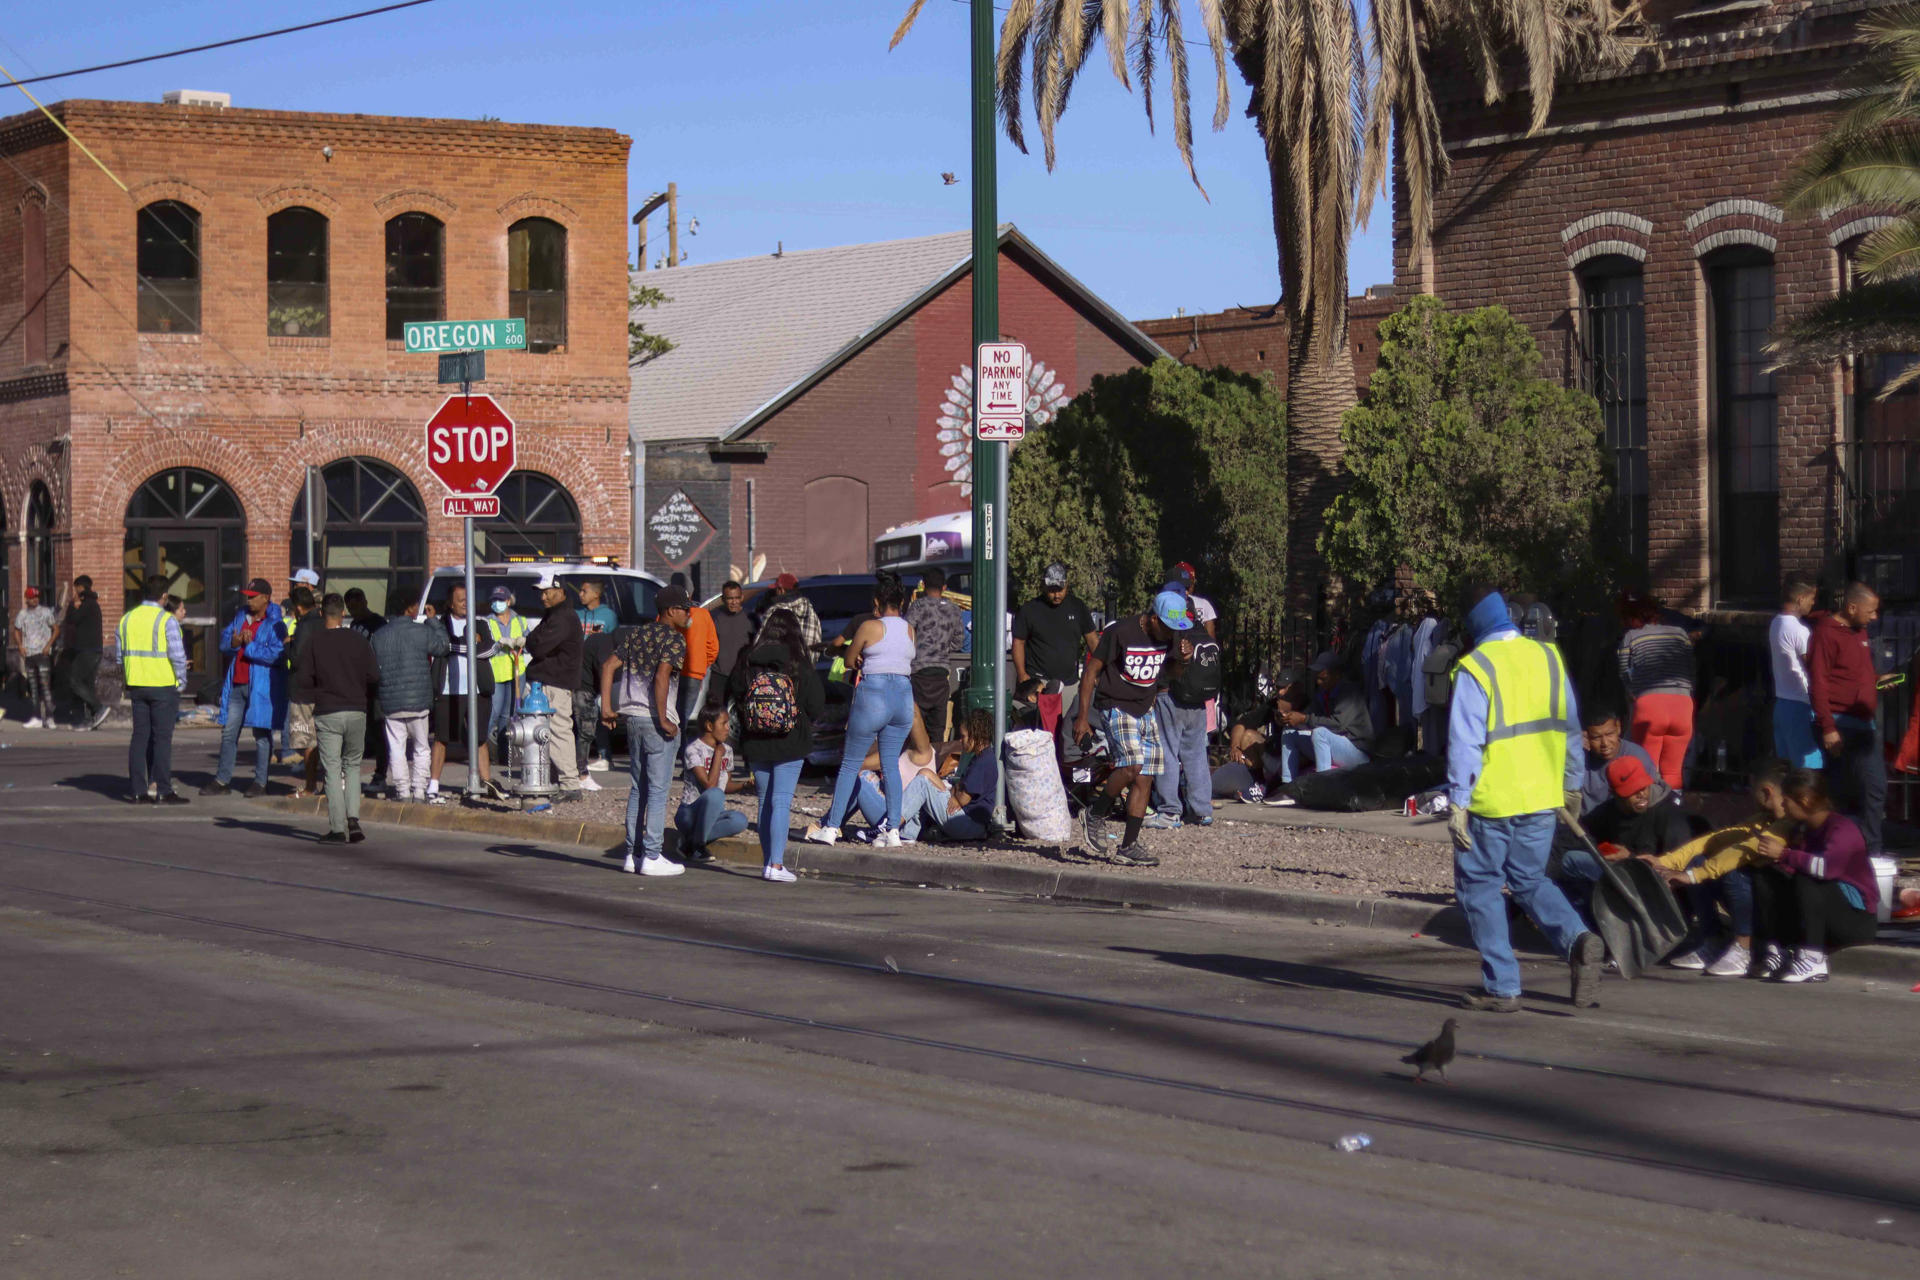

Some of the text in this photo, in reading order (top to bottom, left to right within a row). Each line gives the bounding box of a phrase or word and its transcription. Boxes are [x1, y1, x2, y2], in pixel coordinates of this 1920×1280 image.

[505, 323, 516, 333] ST
[408, 323, 496, 348] OREGON
[505, 335, 523, 345] 600
[993, 350, 1010, 364] NO
[982, 366, 1022, 380] PARKING
[993, 381, 1010, 390] ANY
[991, 391, 1013, 401] TIME
[433, 426, 509, 464] STOP
[447, 499, 495, 514] ALL WAY
[1125, 654, 1144, 666] GO
